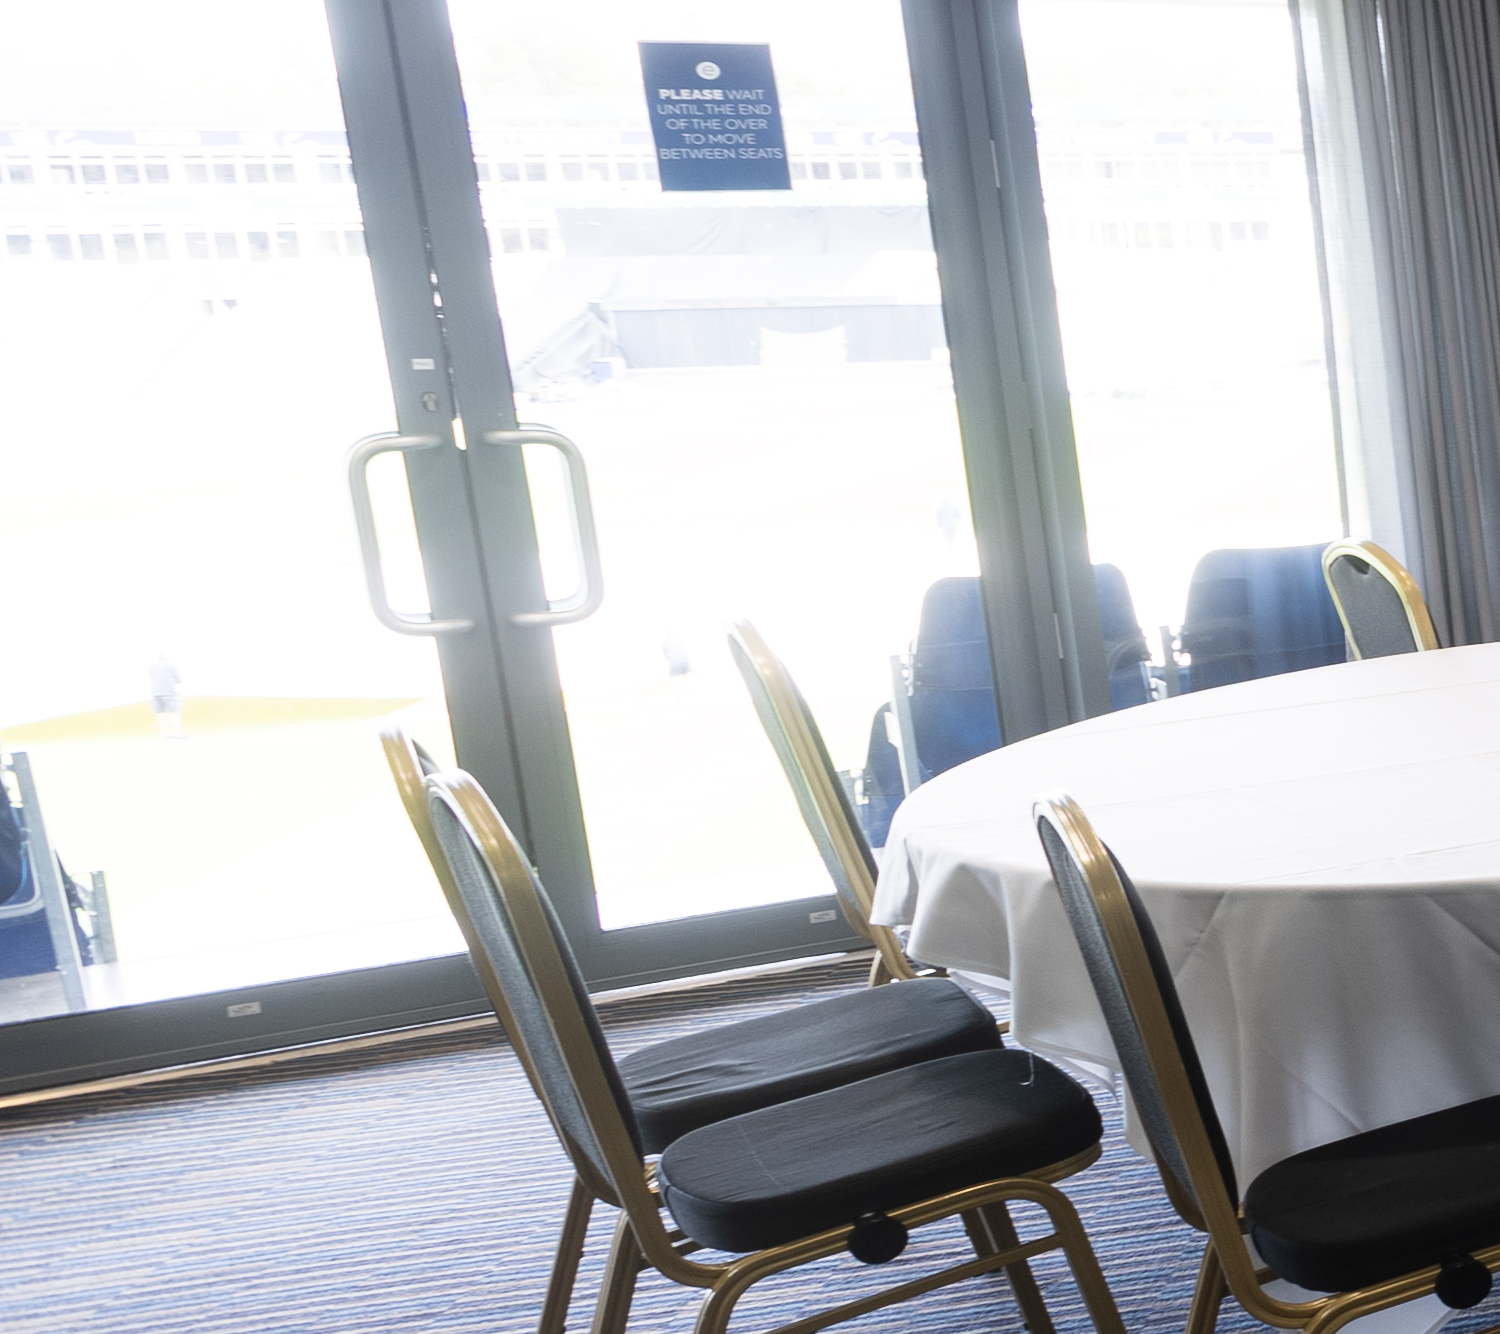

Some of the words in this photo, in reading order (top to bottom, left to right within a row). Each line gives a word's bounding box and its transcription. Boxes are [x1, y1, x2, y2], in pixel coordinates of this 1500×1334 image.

[658, 88, 724, 100] PLEASE
[726, 89, 765, 100] WAIT
[657, 103, 703, 115] UNTIL
[704, 104, 736, 115] THE
[739, 104, 772, 115] END
[666, 118, 689, 130] OF
[691, 119, 722, 130] THE
[725, 119, 768, 130] OVER
[681, 133, 705, 145] TO
[708, 134, 757, 145] MOVE
[660, 148, 737, 160] BETWEEN
[739, 148, 784, 160] SEATS
